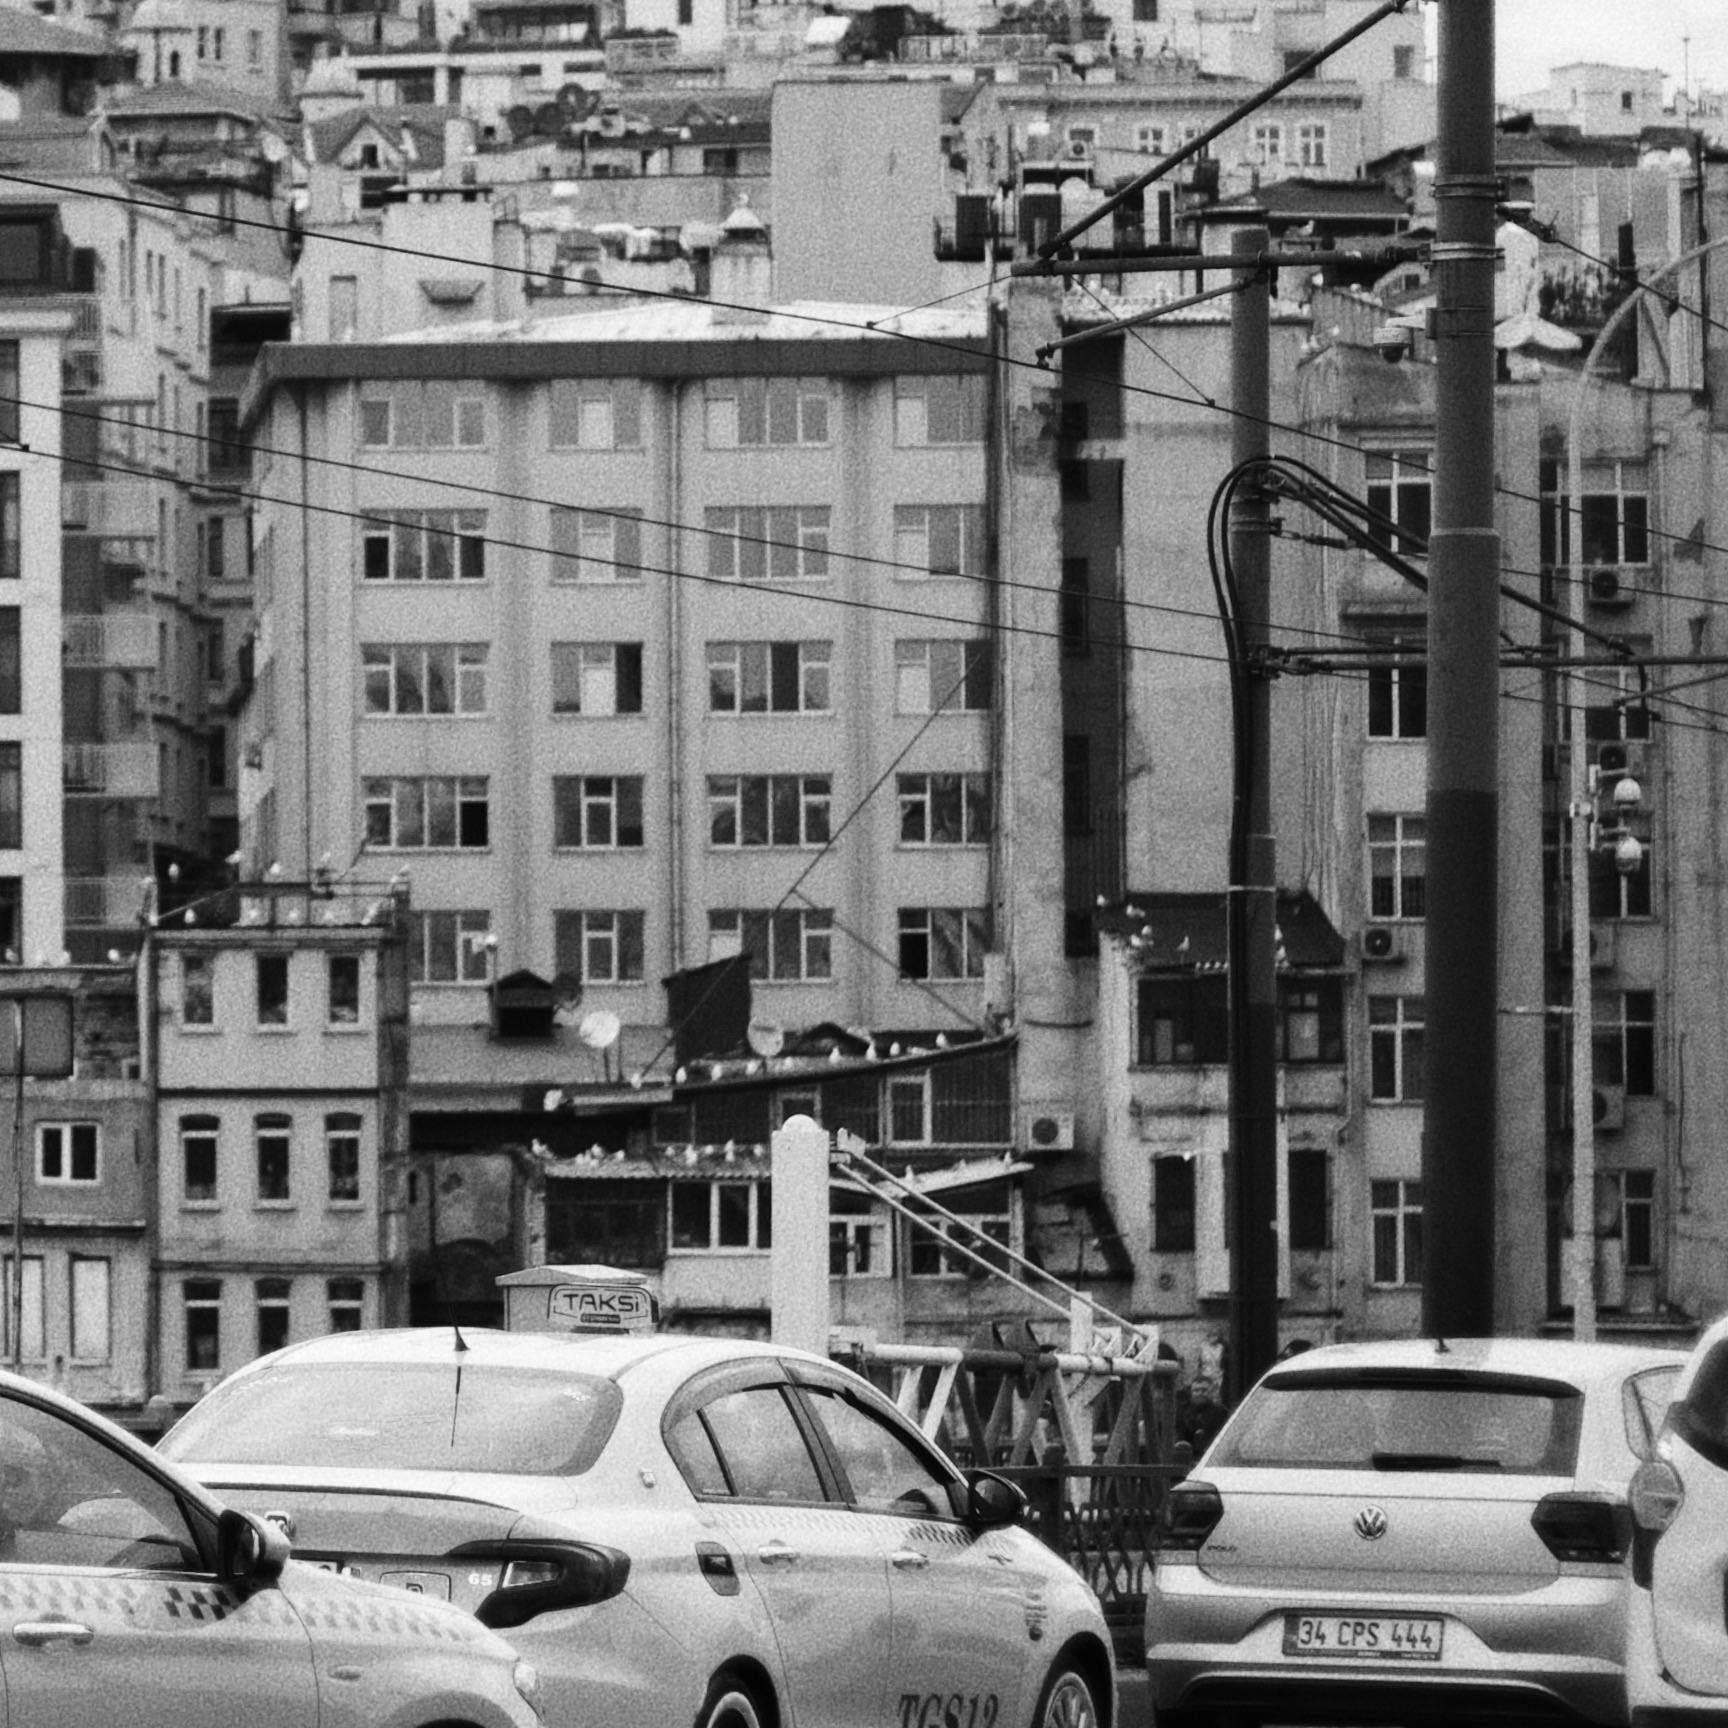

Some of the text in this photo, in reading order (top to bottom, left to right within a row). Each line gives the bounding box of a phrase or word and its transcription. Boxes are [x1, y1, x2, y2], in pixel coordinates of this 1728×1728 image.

[468, 1573, 493, 1586] 65
[1300, 1620, 1432, 1648] 34 CPS 444
